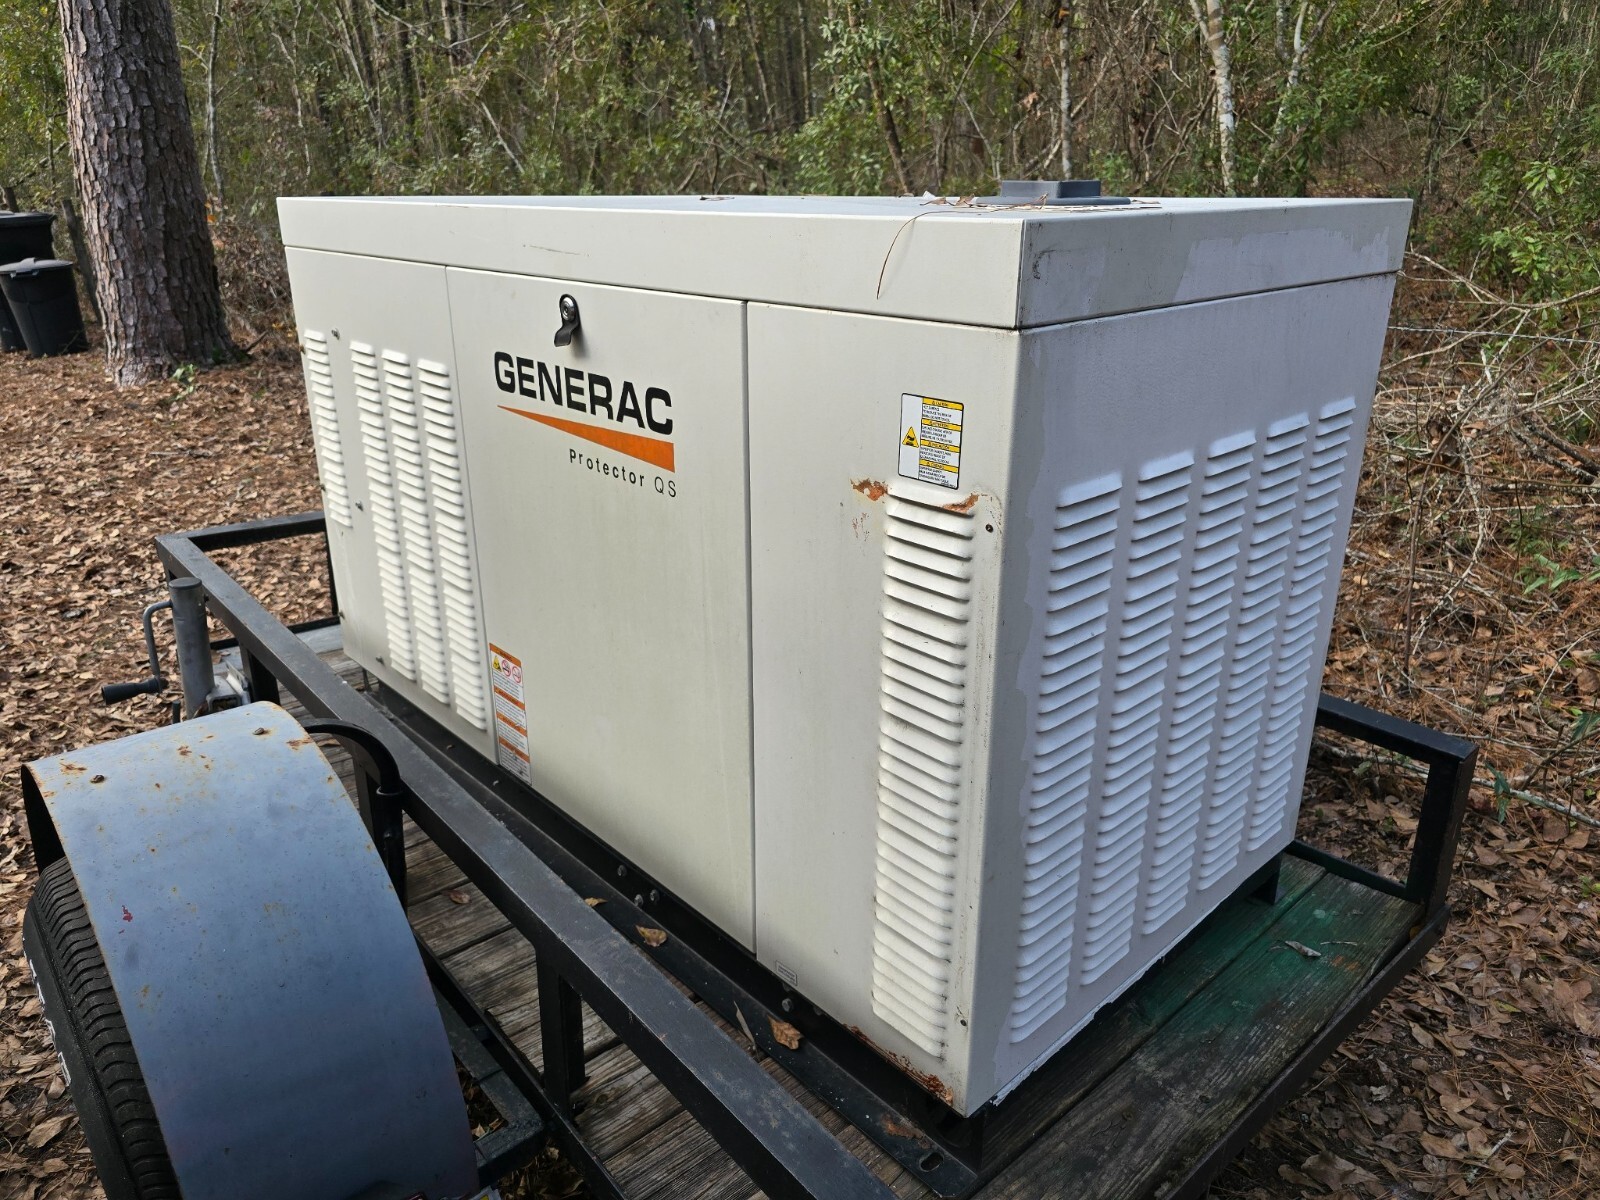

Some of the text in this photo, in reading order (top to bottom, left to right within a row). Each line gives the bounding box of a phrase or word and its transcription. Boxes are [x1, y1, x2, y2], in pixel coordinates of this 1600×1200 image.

[494, 351, 673, 435] GENERAC
[569, 448, 677, 498] Protector QS
